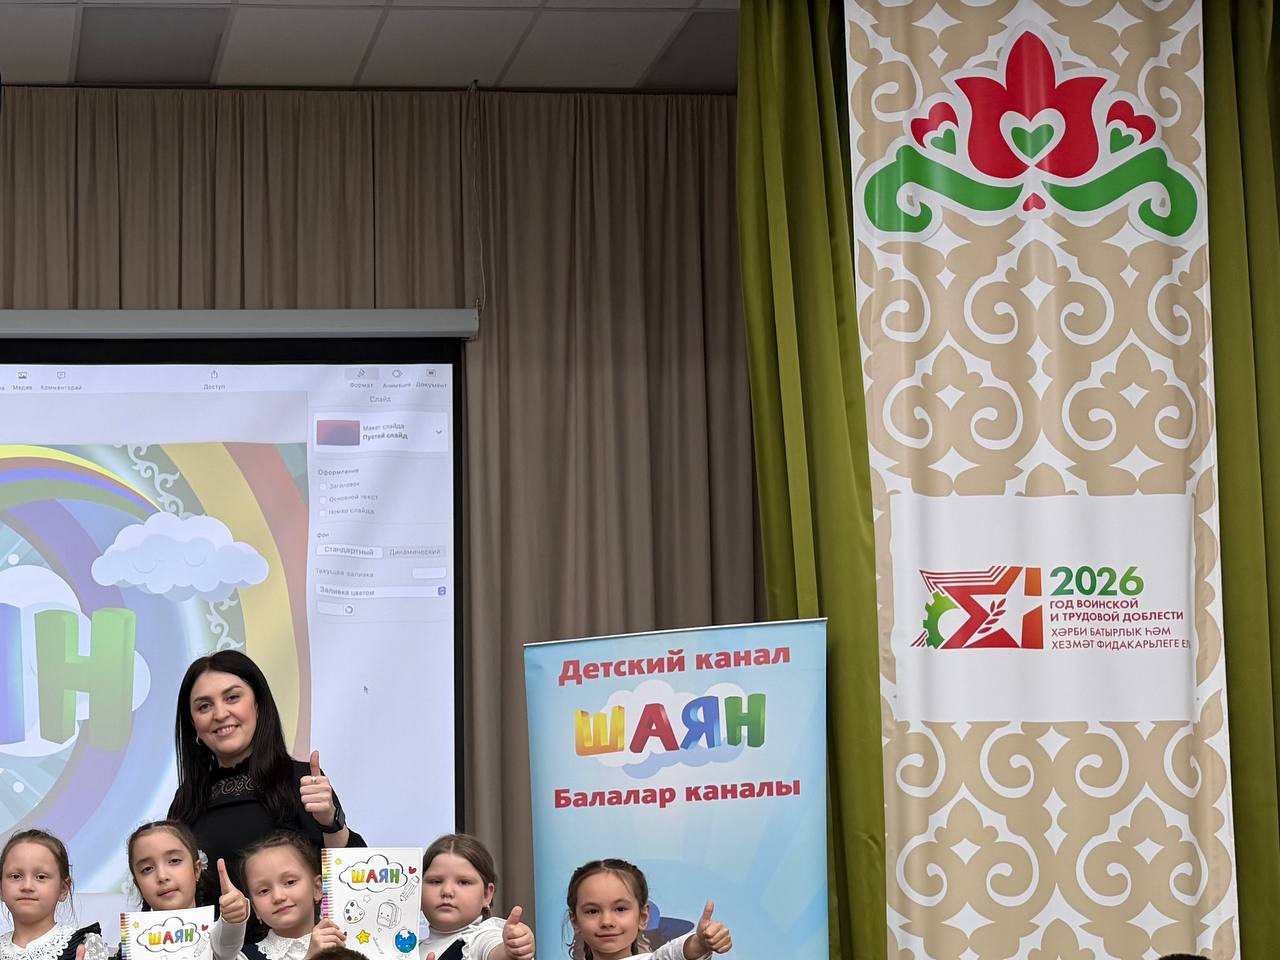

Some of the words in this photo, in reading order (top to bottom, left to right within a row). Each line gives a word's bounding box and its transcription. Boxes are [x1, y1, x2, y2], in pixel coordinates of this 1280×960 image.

[1050, 566, 1144, 596] 2026
[1050, 600, 1074, 610] ГОД
[1076, 598, 1138, 610] ВОИНСКОЙ
[1050, 613, 1059, 622] И
[1061, 610, 1120, 623] ТРУДОВОЙ
[1122, 611, 1184, 623] ДОБЛЕСТИ
[1051, 627, 1087, 637] ХӘРБИ
[1090, 627, 1142, 637] БАТЫРЛЫК
[1051, 640, 1094, 650] ХЕЗМӘТ
[1096, 639, 1180, 651] ФИДАКАРЬЛЕГЕ
[558, 648, 686, 686] Детский
[695, 646, 791, 670] канал
[574, 693, 766, 757] ШАЯН
[554, 787, 676, 809] Балалар
[685, 779, 801, 802] каналы
[351, 868, 400, 884] ШАЯН
[148, 927, 194, 945] ШАЯН
